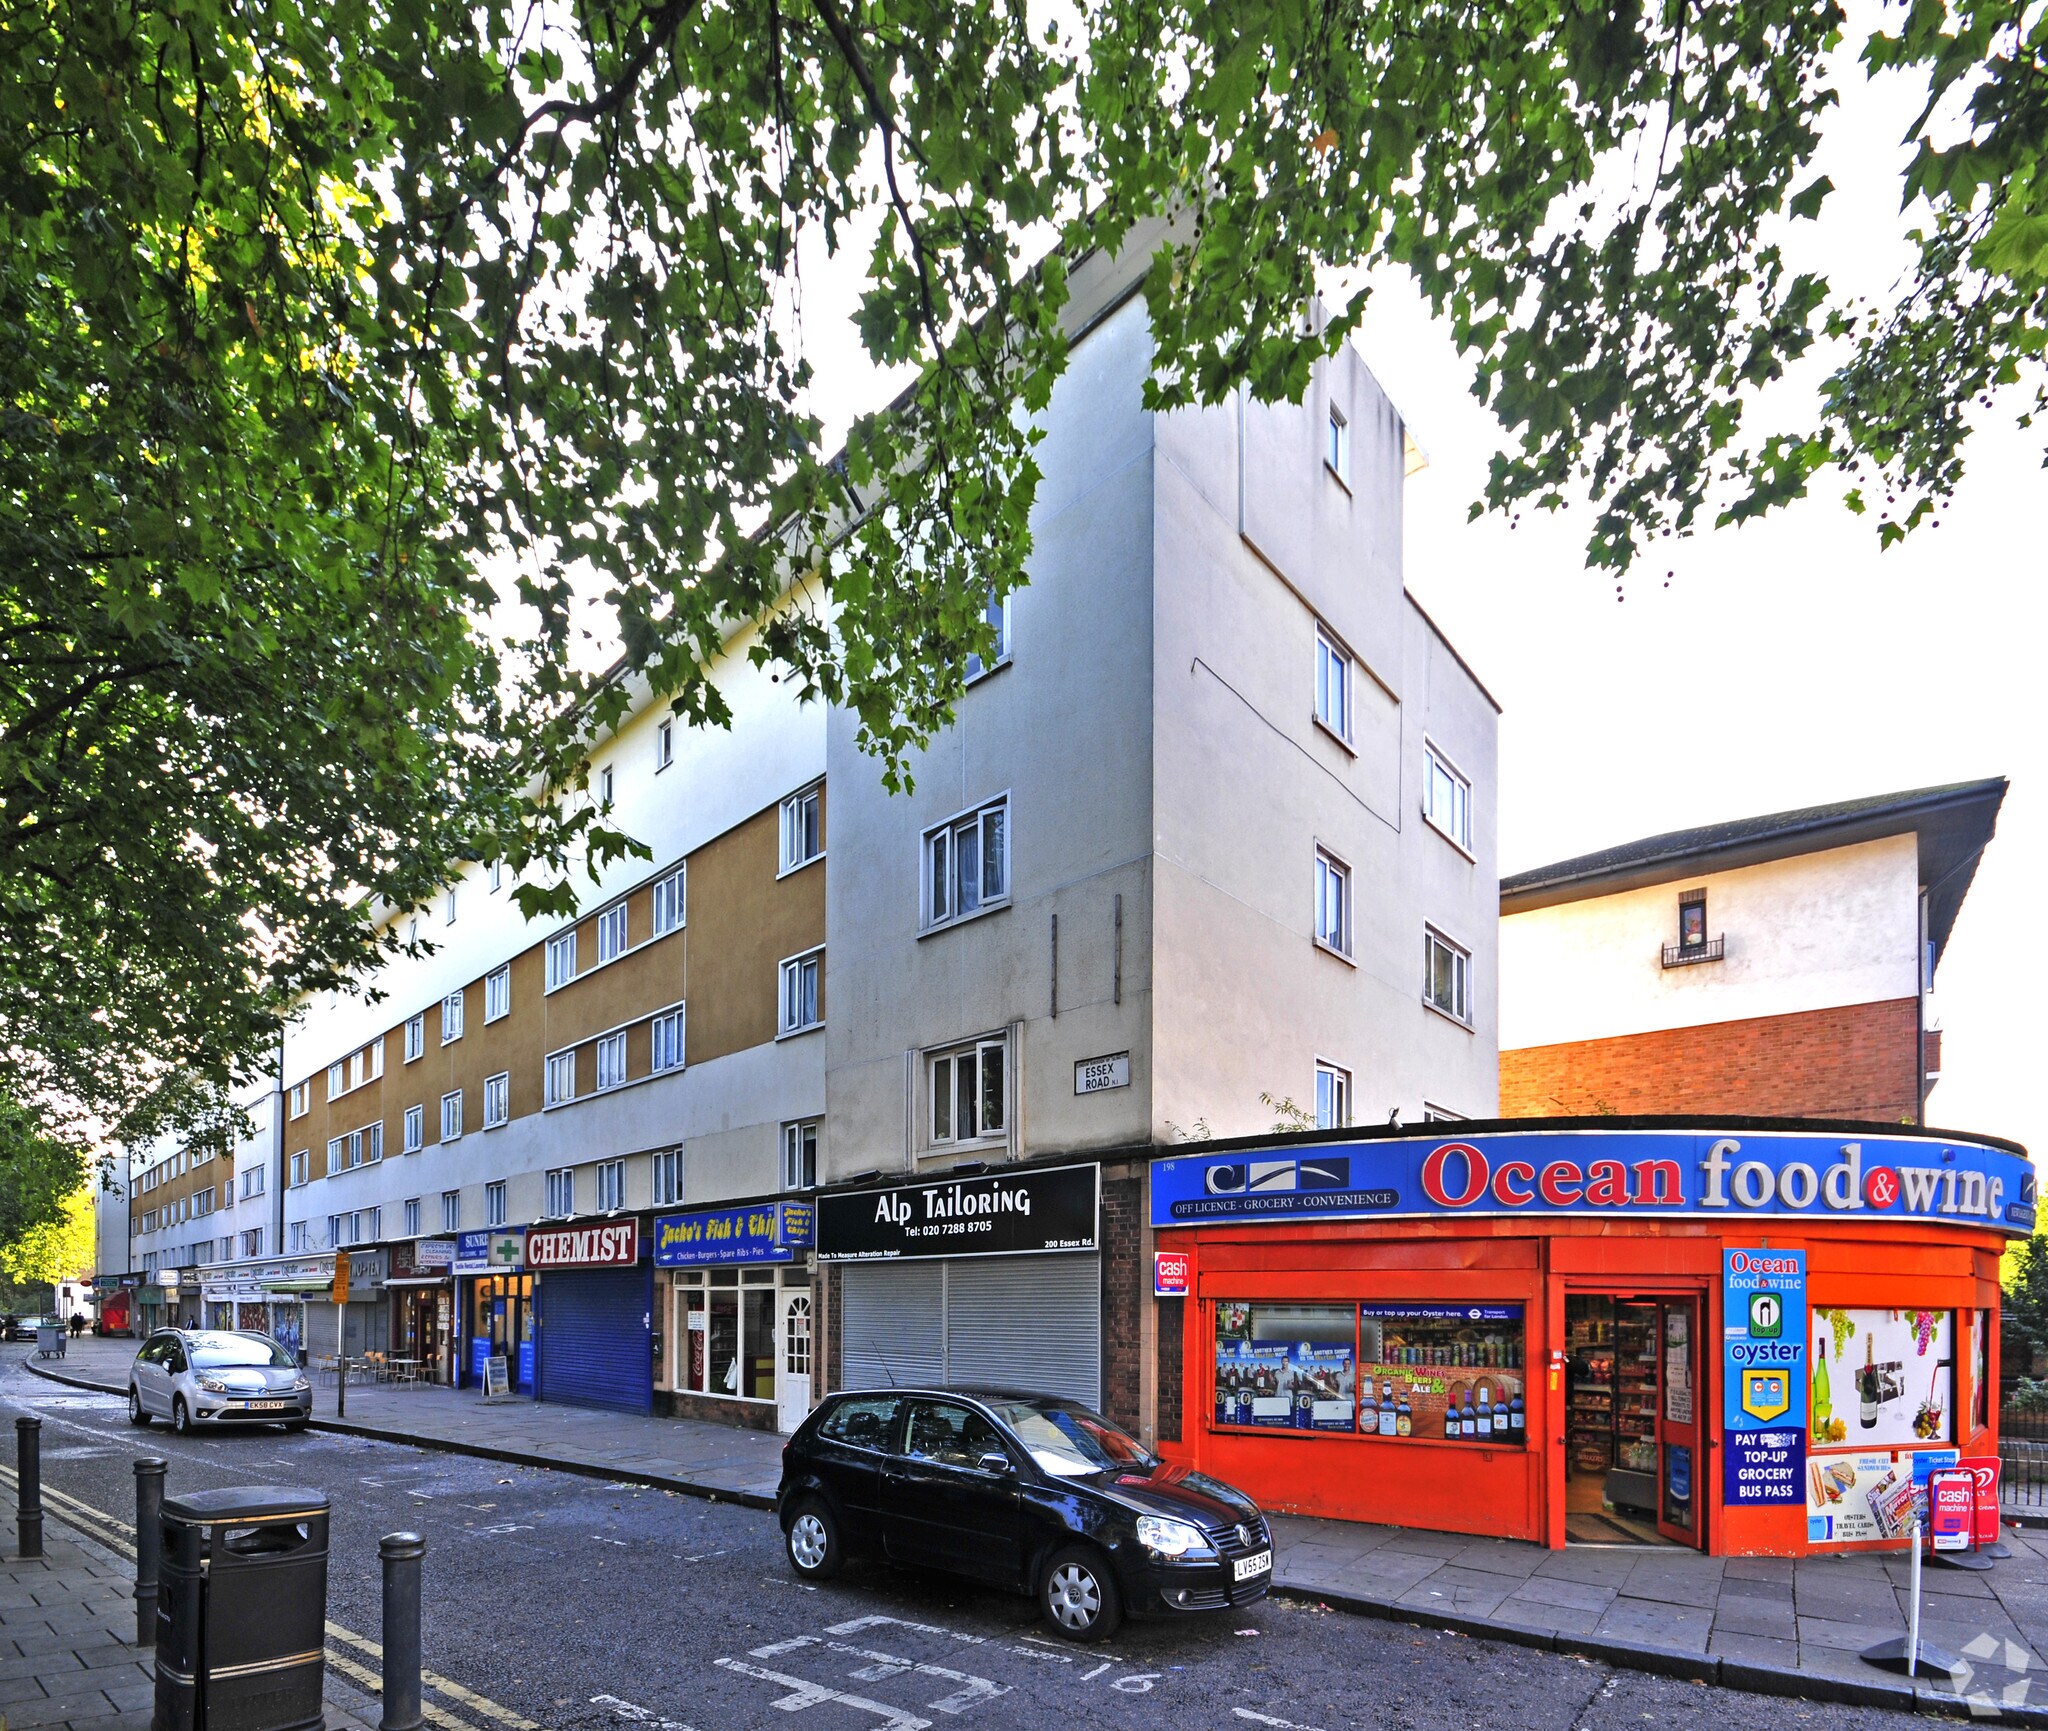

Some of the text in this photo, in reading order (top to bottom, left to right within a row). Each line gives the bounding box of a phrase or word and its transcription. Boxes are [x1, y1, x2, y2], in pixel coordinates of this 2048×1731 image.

[1086, 1062, 1114, 1078] ESSEX
[1086, 1076, 1110, 1090] ROAD
[1162, 1162, 1175, 1172] 198
[1421, 1142, 1686, 1207] Ocean
[1699, 1139, 1865, 1209] food
[1896, 1150, 2003, 1218] wine
[874, 1192, 912, 1226] Alp
[1175, 1203, 1194, 1214] OFF
[1195, 1201, 1237, 1213] LICENCE
[1244, 1197, 1294, 1210] GROCERY
[1303, 1193, 1391, 1207] CONVENIENCE
[706, 1217, 732, 1240] Fish
[749, 1213, 775, 1241] Chip
[904, 1220, 992, 1236] Tel: 020 7288 8705
[465, 1234, 487, 1248] SUNRI
[529, 1226, 631, 1264] CHEMIST
[1044, 1238, 1094, 1248] 200 Essex Rd.
[676, 1248, 764, 1260] Chicken Burgers Spare Ribs Pies
[858, 1250, 882, 1258] Alteration
[884, 1250, 900, 1258] Repair
[1160, 1258, 1187, 1276] cash
[1730, 1252, 1799, 1274] Ocean
[1162, 1276, 1184, 1284] machine
[1729, 1274, 1760, 1288] food
[1768, 1276, 1802, 1289] wine
[1422, 1310, 1444, 1318] Oyster
[1732, 1341, 1801, 1366] oyster
[1432, 1378, 1444, 1393] &
[1735, 1434, 1757, 1445] PAY
[1744, 1451, 1788, 1462] TOP-UP
[1738, 1468, 1793, 1480] GROCERY
[1739, 1485, 1793, 1497] BUS PASS
[1938, 1487, 1969, 1502] cash
[1939, 1504, 1967, 1512] machine
[1238, 1558, 1257, 1576] LV55
